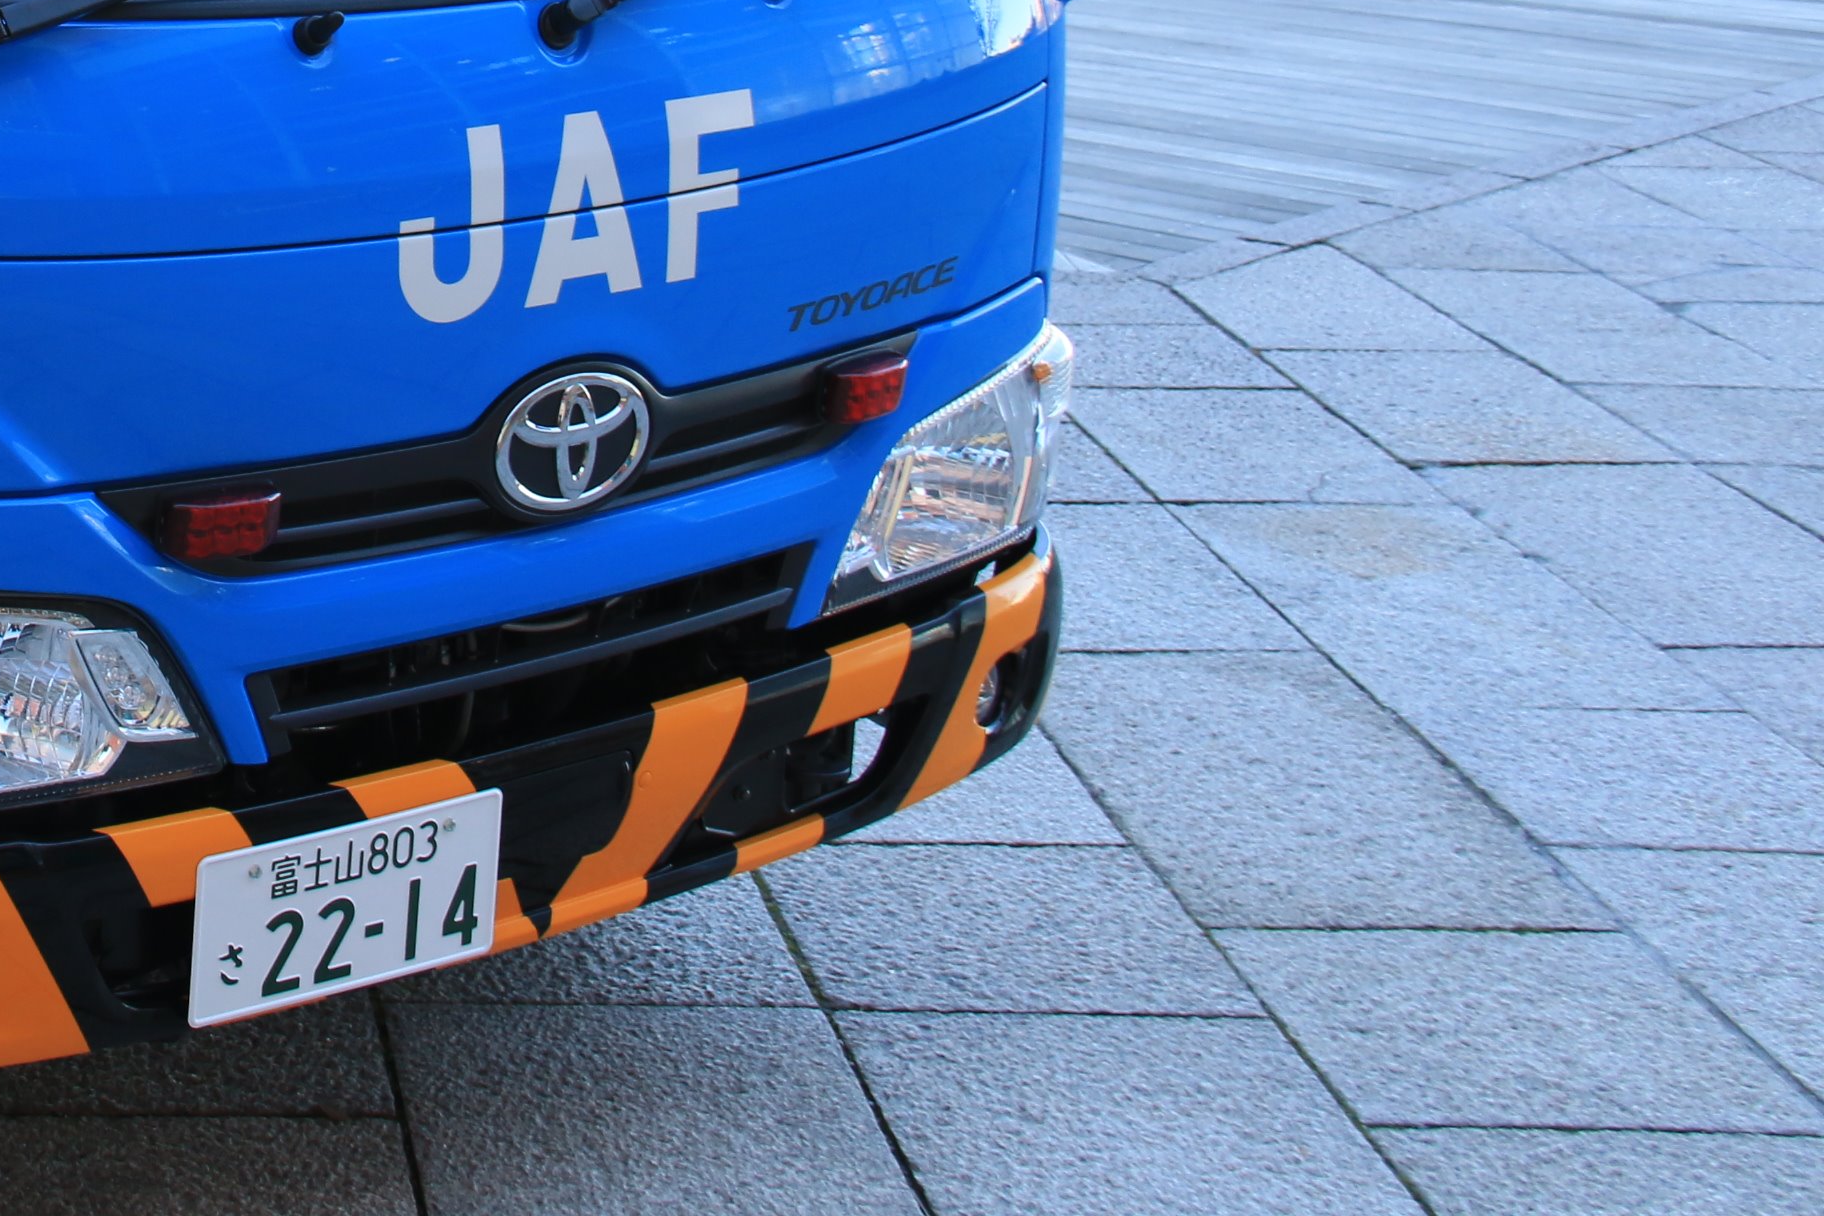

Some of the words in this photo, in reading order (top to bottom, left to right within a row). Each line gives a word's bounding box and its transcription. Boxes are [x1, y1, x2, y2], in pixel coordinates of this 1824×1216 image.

[398, 87, 756, 324] JAF
[787, 255, 959, 333] TOYOACE
[219, 942, 244, 986] さ
[260, 863, 479, 998] 22-14
